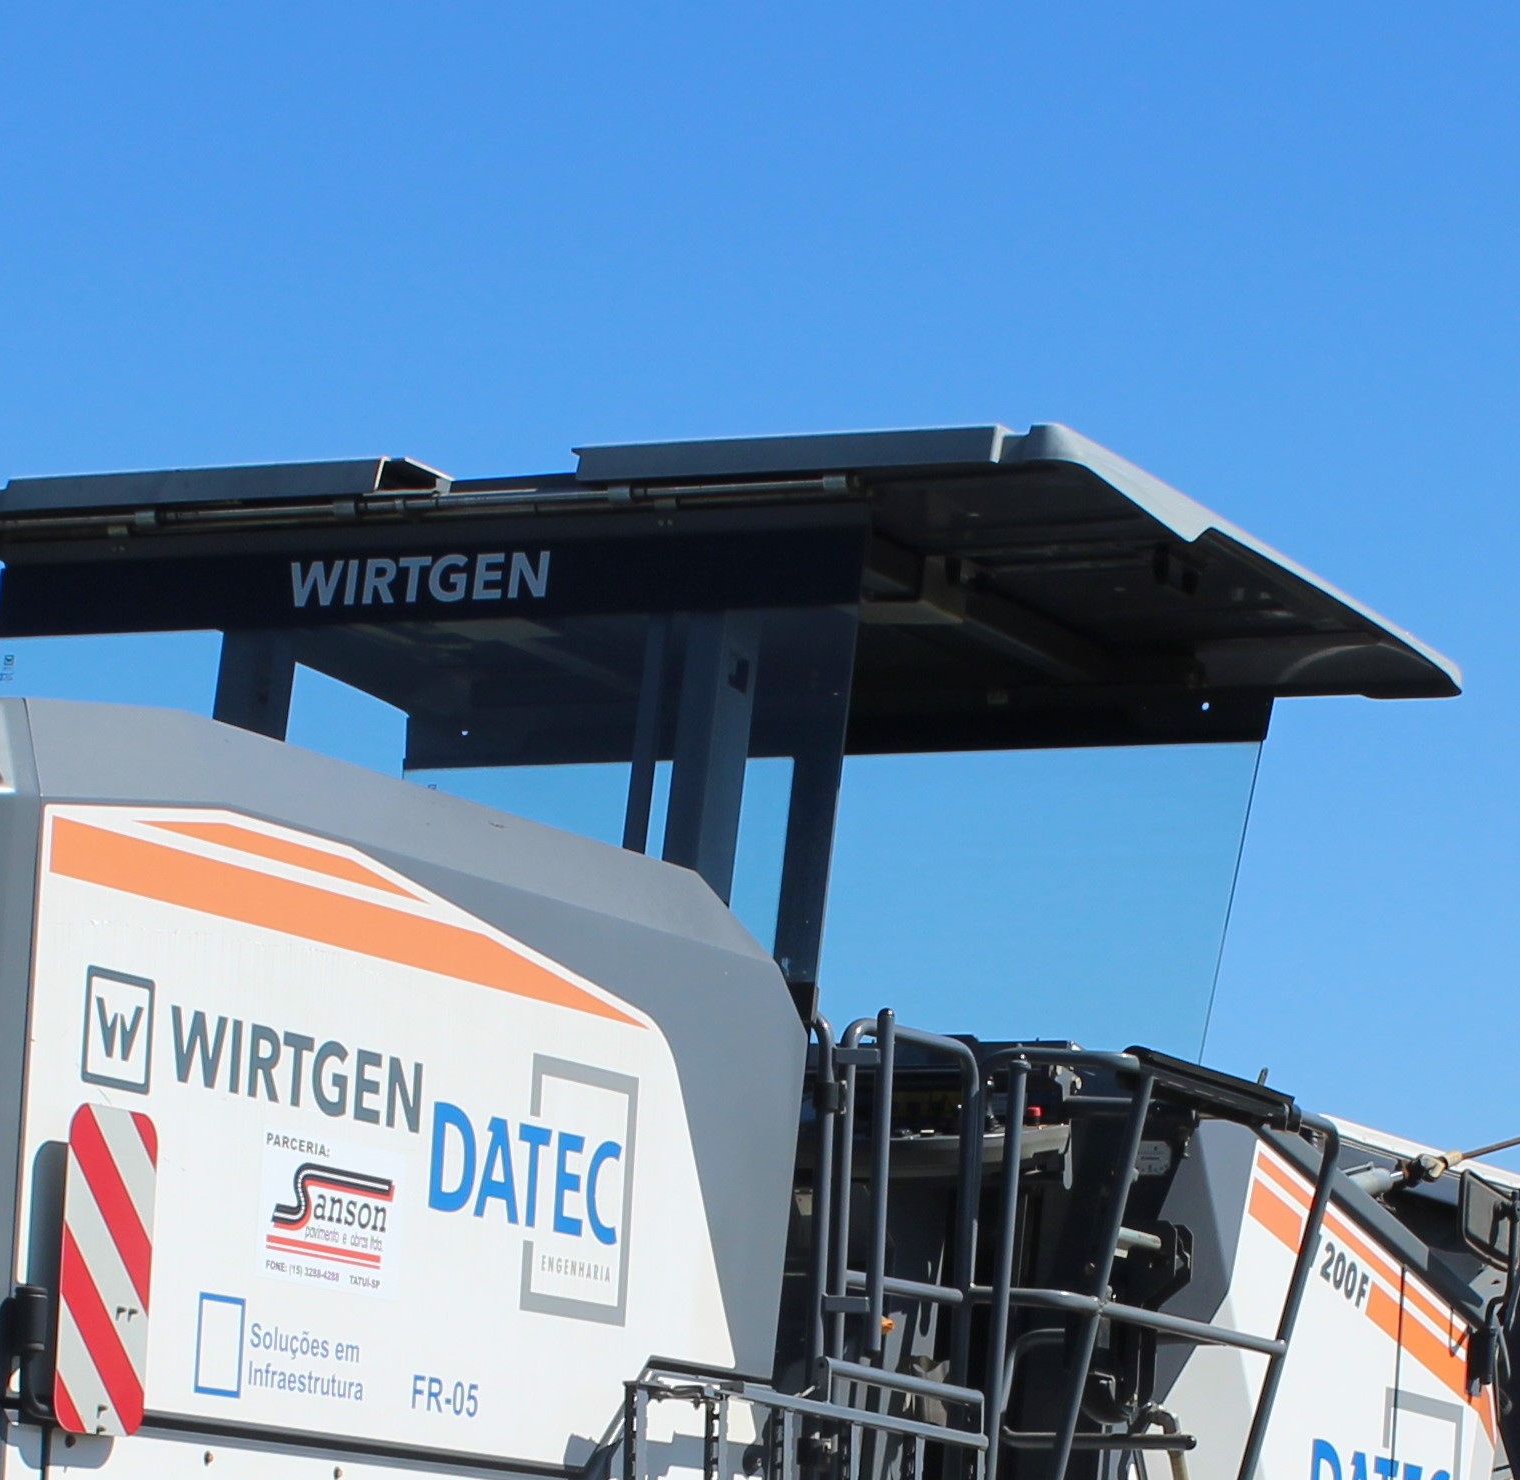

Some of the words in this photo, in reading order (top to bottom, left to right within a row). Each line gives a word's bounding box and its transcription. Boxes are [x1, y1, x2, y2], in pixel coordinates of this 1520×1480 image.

[291, 551, 550, 607] WIRTGEN
[171, 1004, 423, 1133] WIRTGEN
[266, 1132, 330, 1157] PARCERIA:
[428, 1101, 622, 1245] DATEC
[270, 1162, 395, 1233] Sanson
[266, 1259, 287, 1272] FONE:
[541, 1255, 610, 1282] ENGENHARIA
[1320, 1241, 1370, 1309] 200F
[250, 1323, 329, 1360] Soluções
[335, 1342, 360, 1363] em
[248, 1361, 364, 1401] Infraestrutura
[412, 1374, 479, 1418] FR-05
